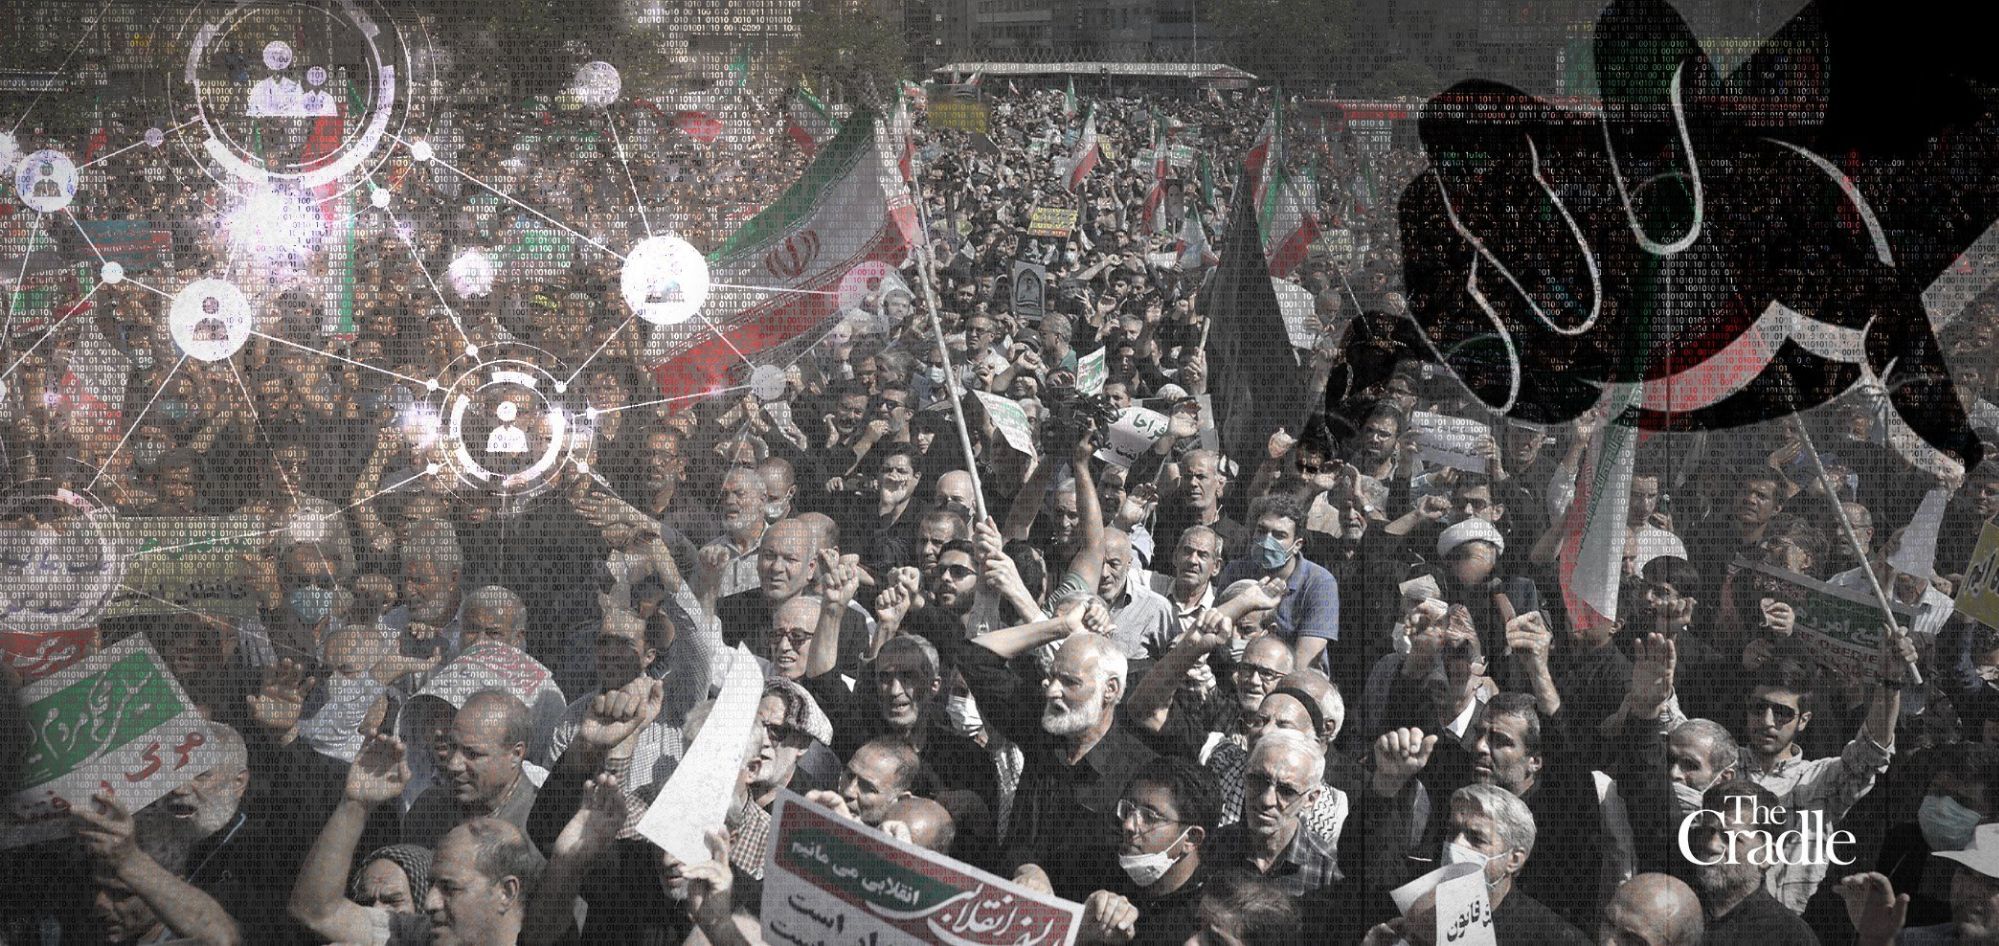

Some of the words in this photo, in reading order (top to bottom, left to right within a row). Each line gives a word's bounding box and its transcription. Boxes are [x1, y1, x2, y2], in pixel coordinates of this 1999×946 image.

[861, 875, 921, 907] انقلابی
[788, 893, 845, 935] است
[1446, 898, 1481, 942] قانون
